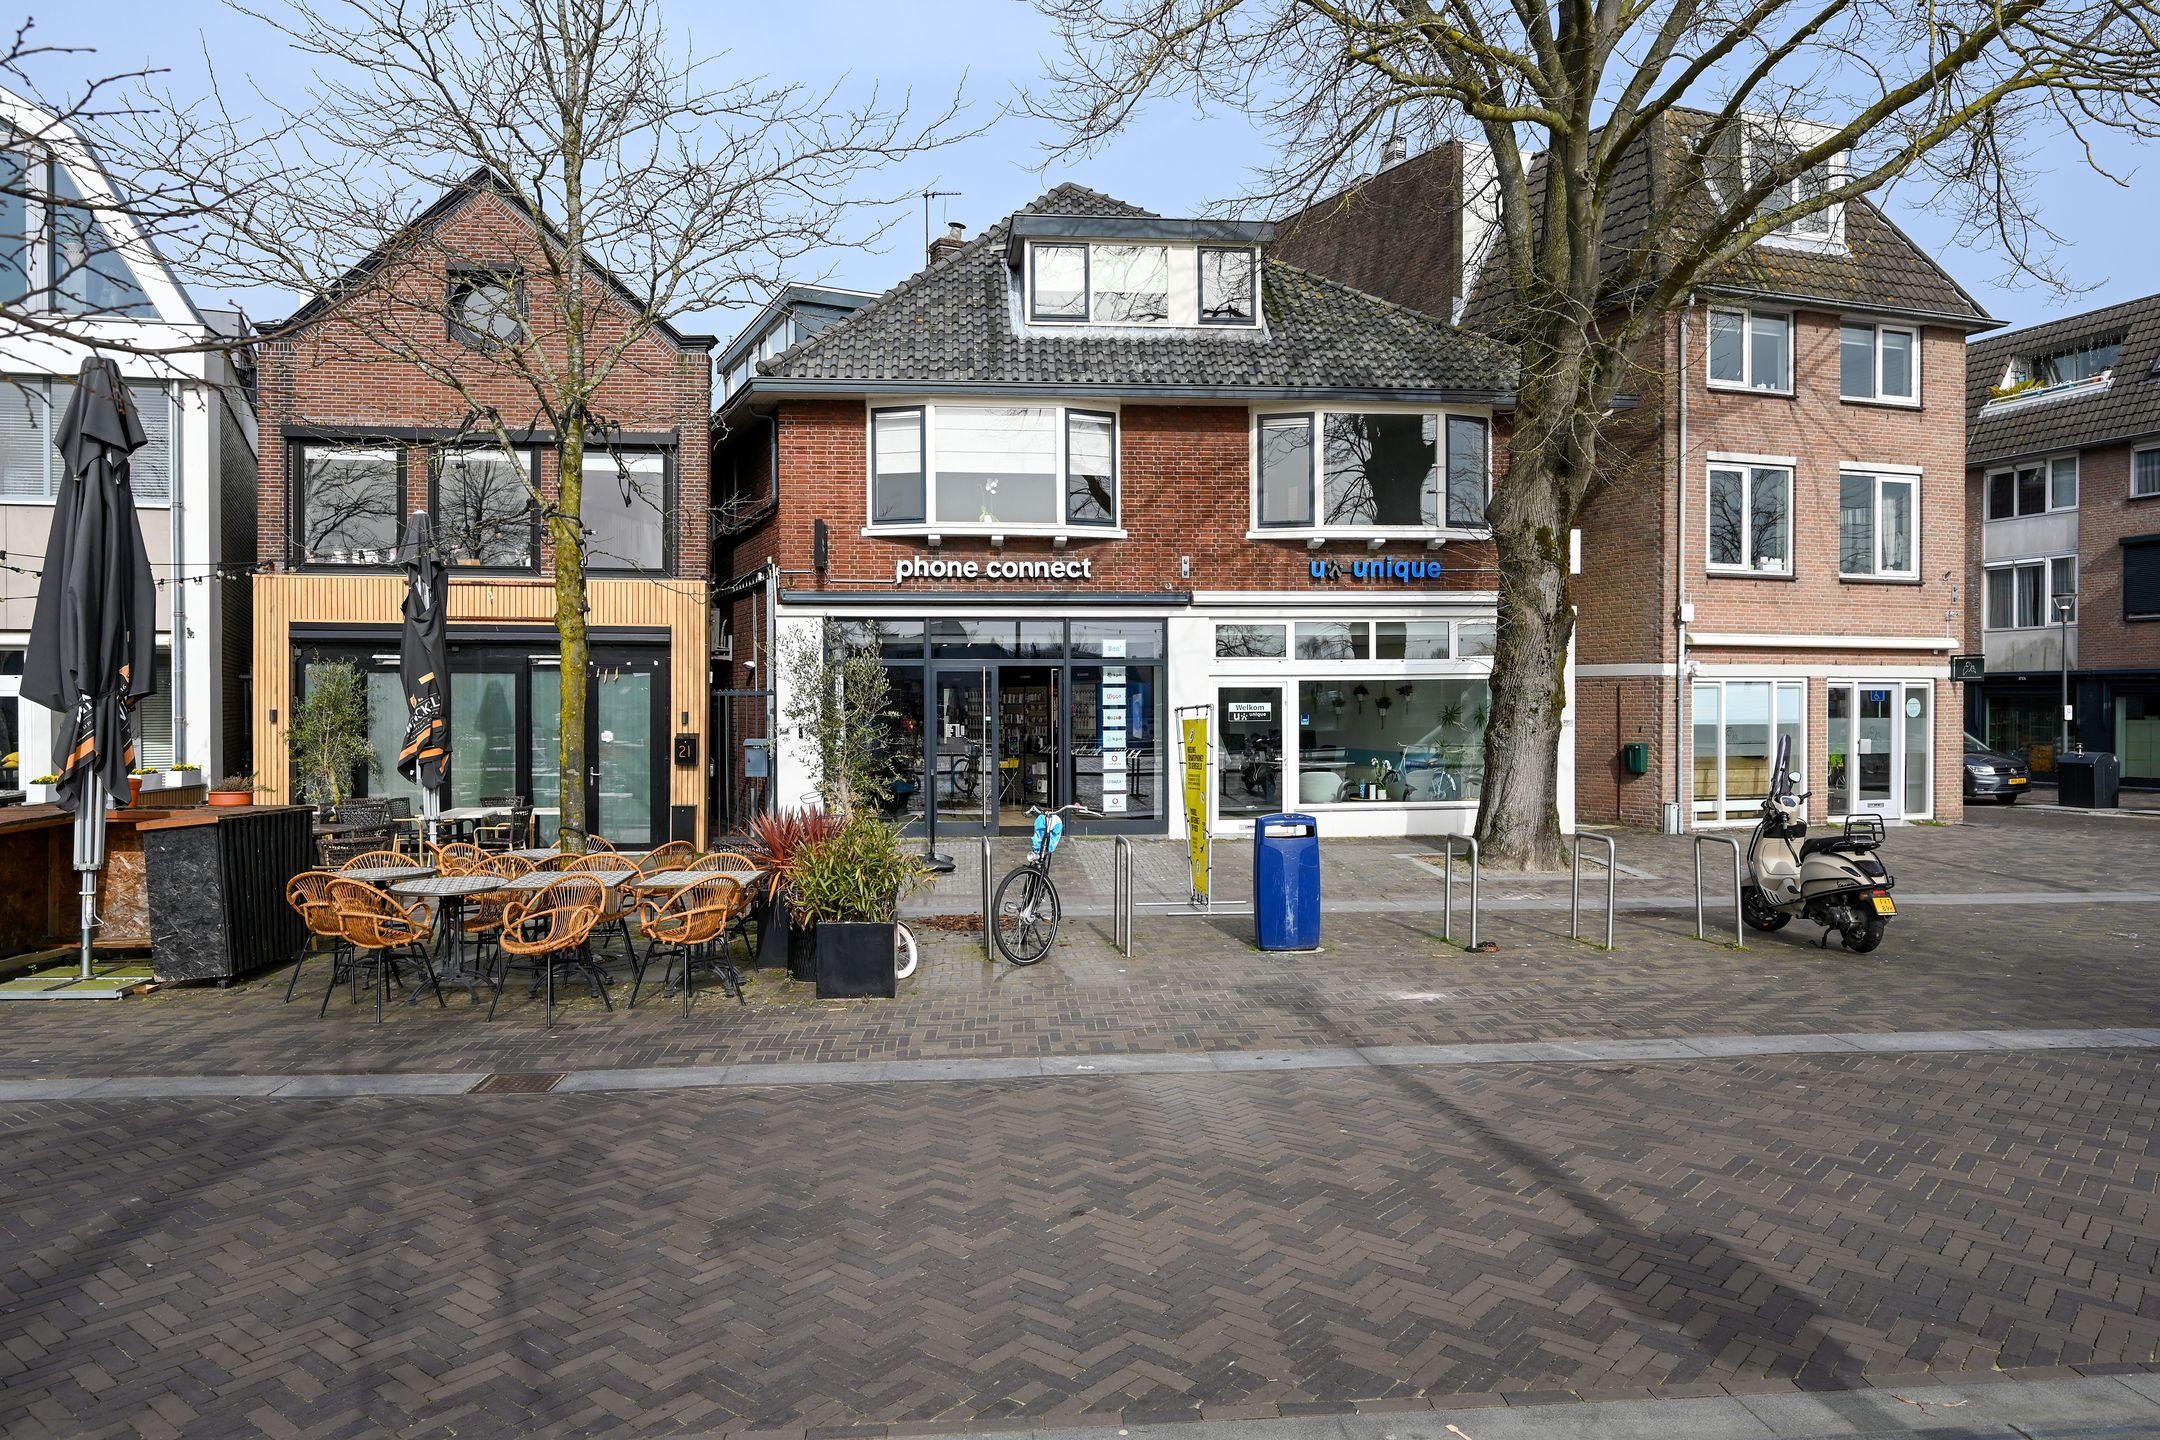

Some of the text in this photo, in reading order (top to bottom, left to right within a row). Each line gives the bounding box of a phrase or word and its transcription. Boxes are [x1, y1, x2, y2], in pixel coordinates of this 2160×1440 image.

[896, 555, 1092, 584] phone connect
[1353, 555, 1442, 582] unique
[678, 745, 691, 758] 21
